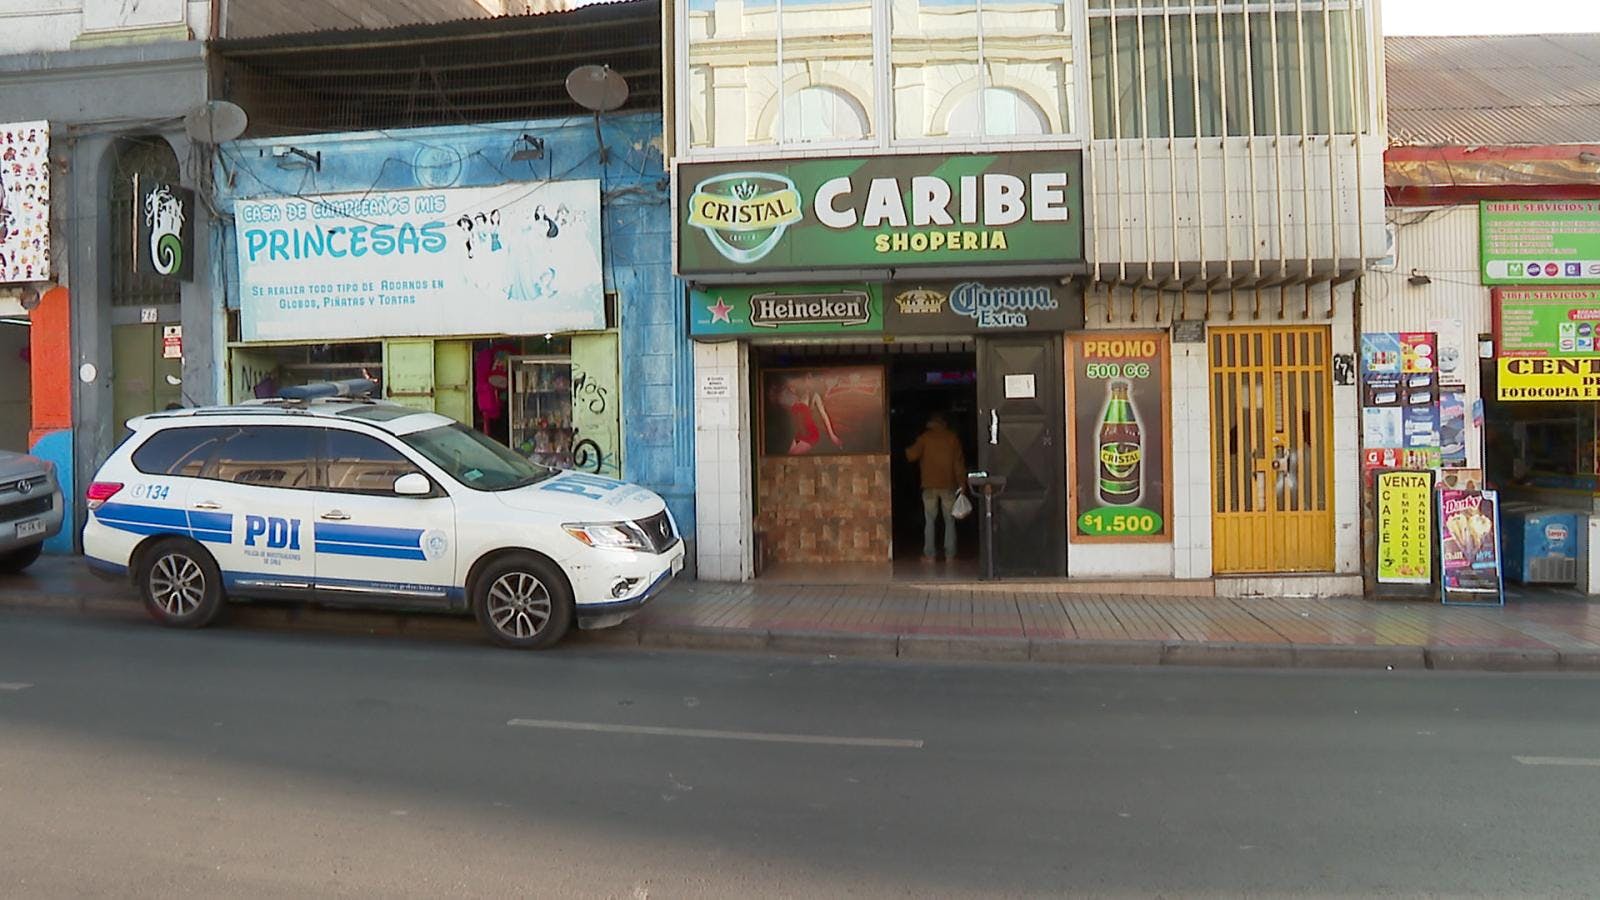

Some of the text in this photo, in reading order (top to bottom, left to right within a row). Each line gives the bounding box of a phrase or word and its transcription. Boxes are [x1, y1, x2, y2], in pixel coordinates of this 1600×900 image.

[243, 204, 281, 222] CASA
[286, 202, 306, 221] DE
[415, 194, 446, 214] MIS
[814, 173, 1068, 228] CARIBE
[1487, 203, 1520, 213] CIBER
[1524, 203, 1584, 212] SERVICIOS
[701, 199, 793, 223] CRISTAL
[244, 221, 447, 262] PRINCESAS
[875, 231, 1007, 252] SHOPERIA
[1534, 292, 1587, 300] SERVICIOS
[759, 296, 862, 320] Heineken
[977, 309, 1028, 328] Extra
[1083, 340, 1156, 358] PROMO
[1087, 363, 1150, 379] 500 CC
[1383, 476, 1426, 488] VENTA
[146, 484, 169, 500] 134
[245, 515, 300, 550] PDI
[1084, 514, 1154, 532] $1.500
